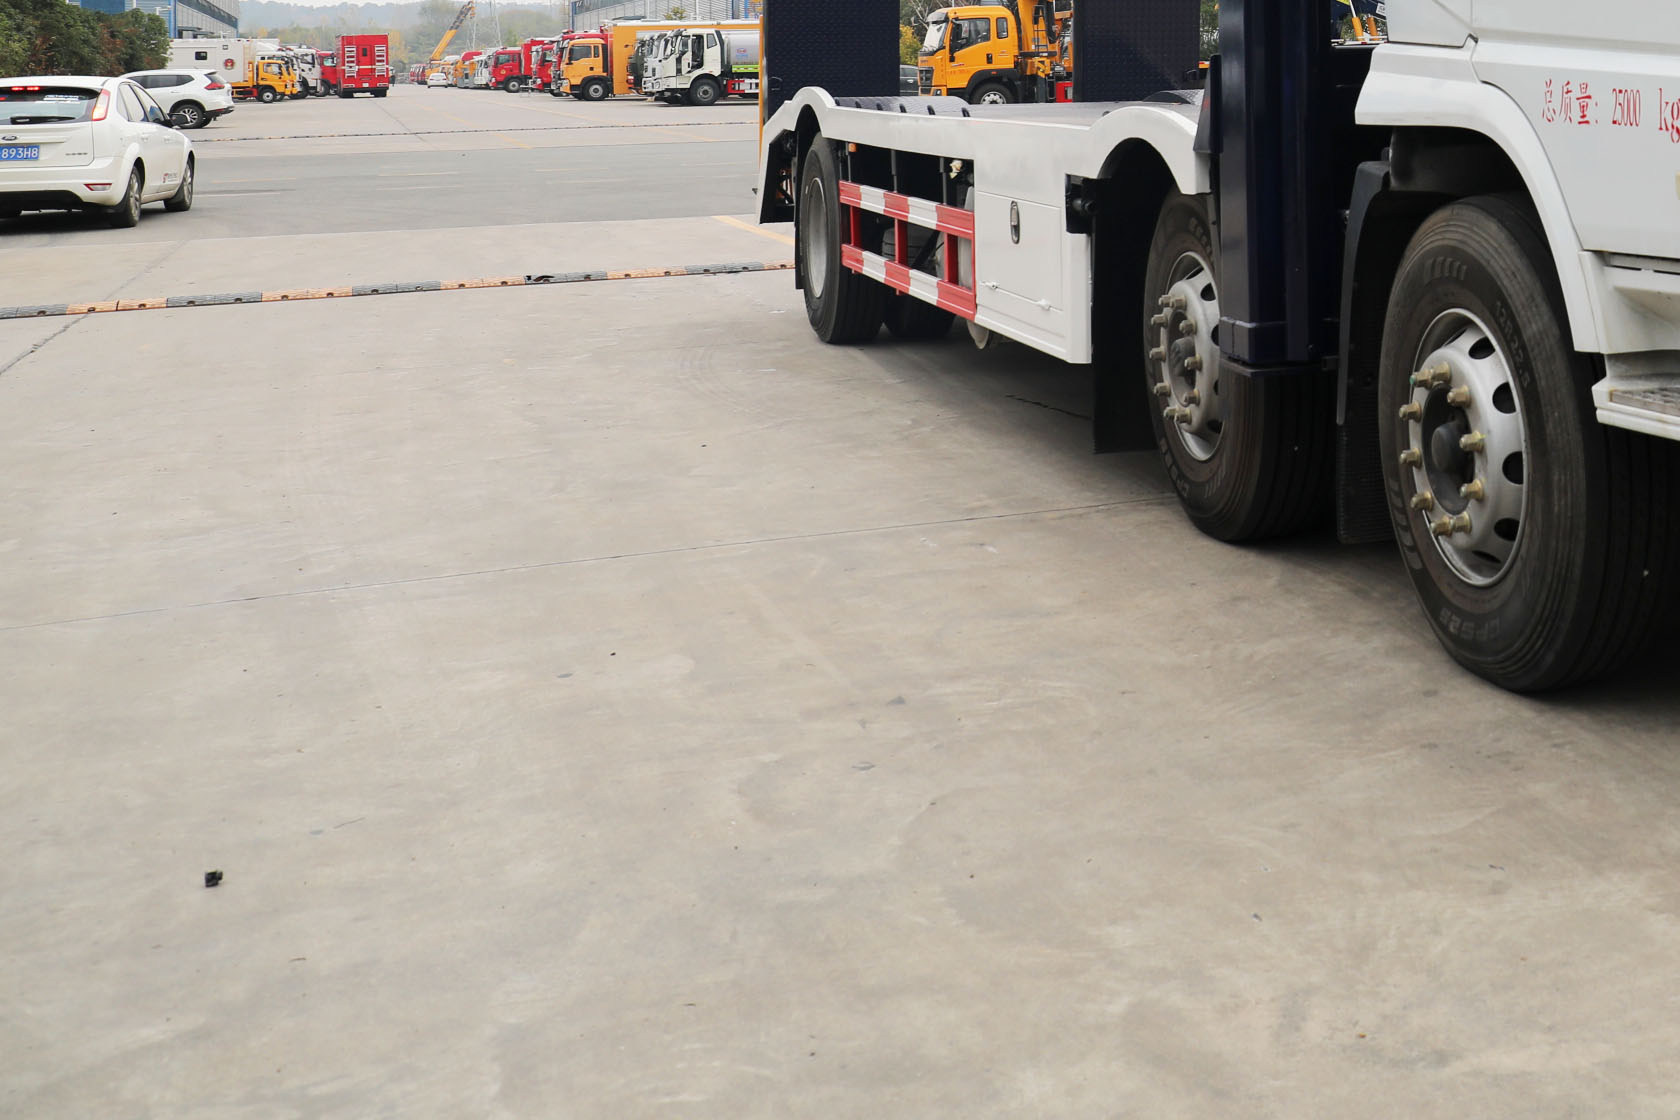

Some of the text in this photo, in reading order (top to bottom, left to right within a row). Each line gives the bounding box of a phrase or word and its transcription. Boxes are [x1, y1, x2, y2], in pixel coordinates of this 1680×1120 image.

[1612, 88, 1641, 127] 25000
[1658, 87, 1680, 144] kg
[1, 147, 38, 158] 893H8
